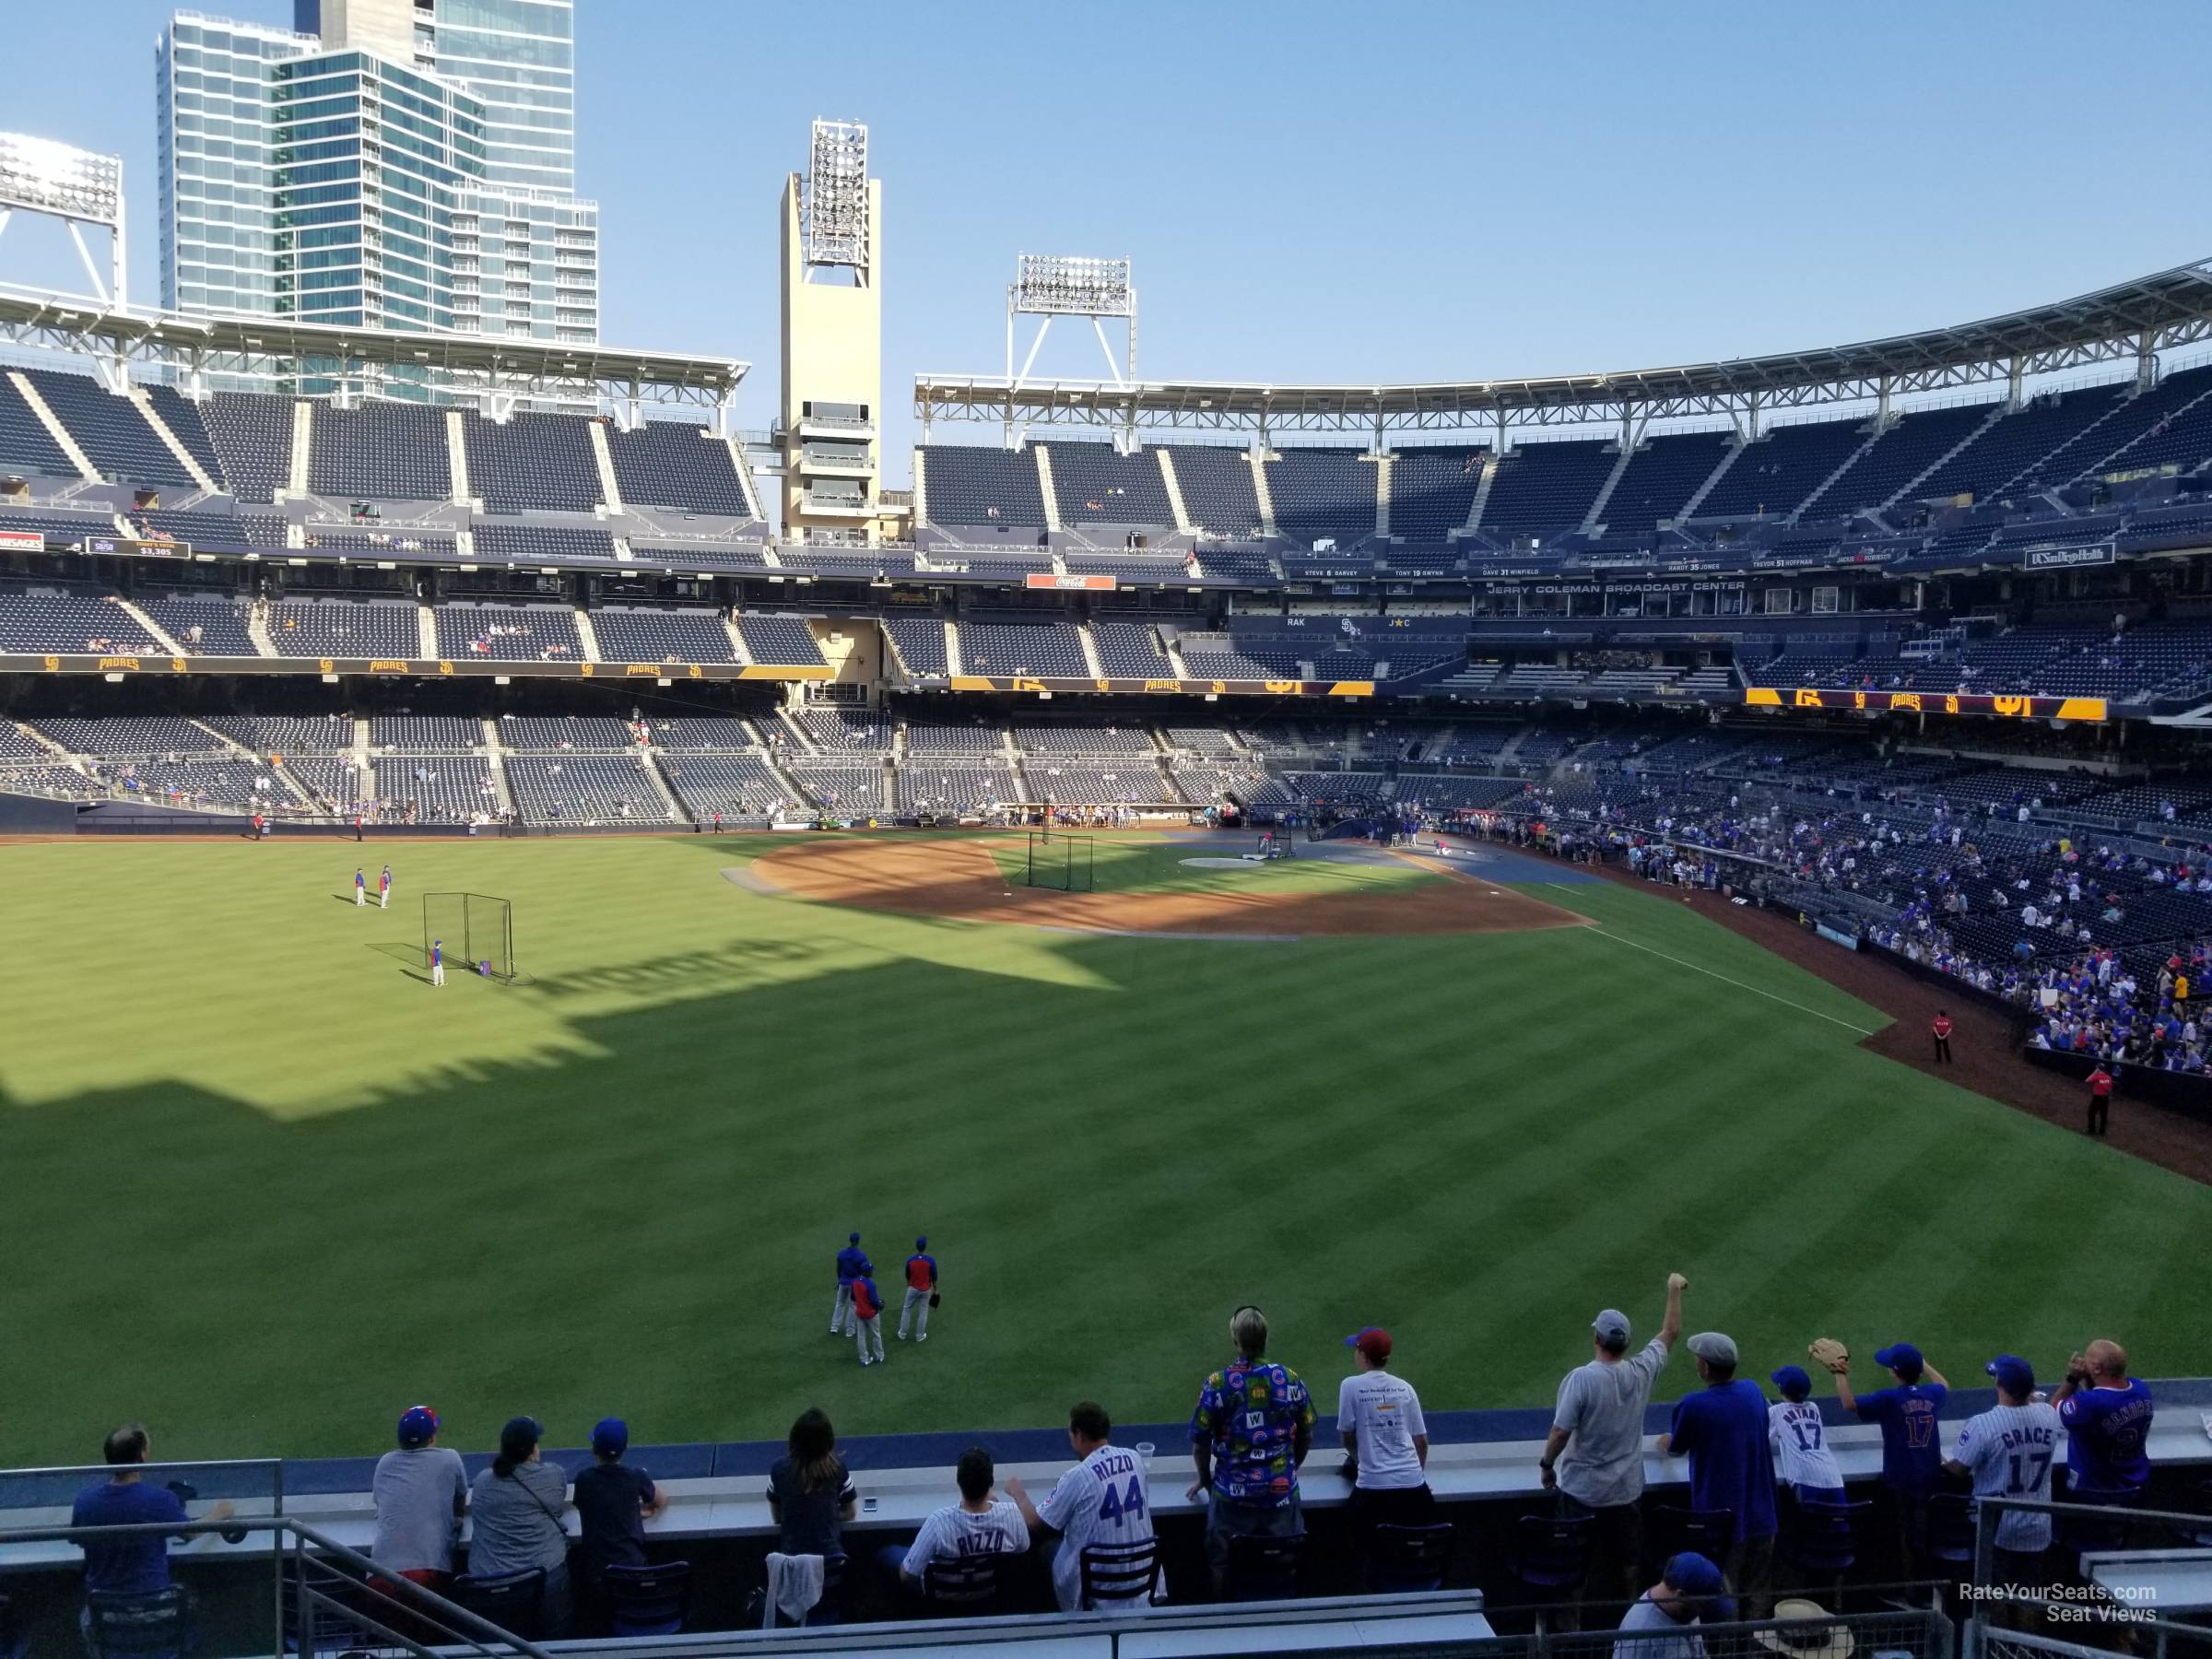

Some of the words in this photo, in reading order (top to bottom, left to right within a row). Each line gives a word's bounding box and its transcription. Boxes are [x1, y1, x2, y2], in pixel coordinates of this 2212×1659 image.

[1488, 586, 1530, 594] JERRY
[1535, 585, 1600, 594] COLEMAN
[1606, 582, 1688, 593] BROADCAST
[1693, 581, 1746, 591] CENTER
[99, 657, 139, 671] PADRES
[370, 661, 408, 673] PADRES
[627, 664, 661, 677] PADRES
[1144, 679, 1182, 693] PADRES
[1891, 693, 1922, 712] PADRES
[1791, 1423, 1820, 1452] 17
[1905, 1415, 1934, 1448] 17
[2001, 1427, 2052, 1449] GRACE
[1091, 1454, 1134, 1481] RIZZO
[2007, 1452, 2052, 1493] 17
[1100, 1475, 1144, 1527] 44
[957, 1529, 1005, 1557] RIZZO
